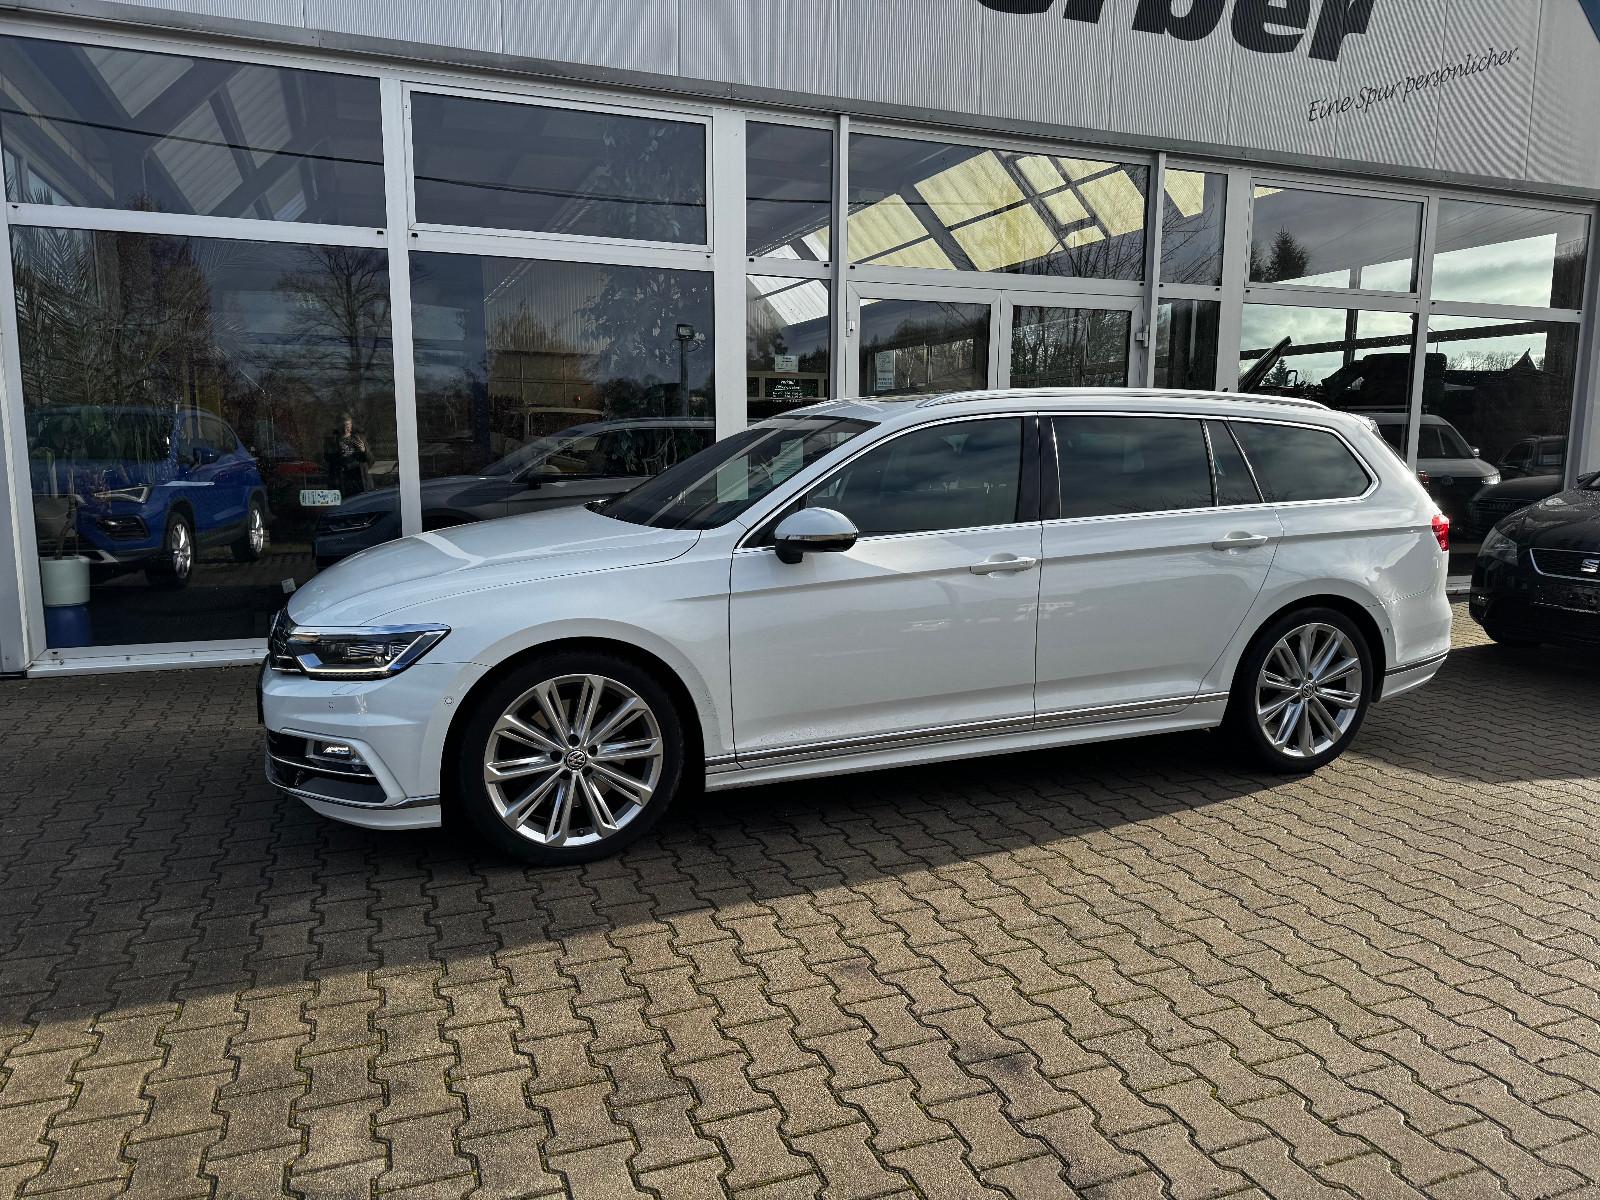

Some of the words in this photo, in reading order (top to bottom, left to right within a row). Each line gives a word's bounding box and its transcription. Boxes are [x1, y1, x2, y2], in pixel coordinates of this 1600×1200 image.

[1308, 96, 1355, 122] Eine
[1355, 81, 1402, 113] Spur
[1402, 47, 1520, 102] persönlicher.
